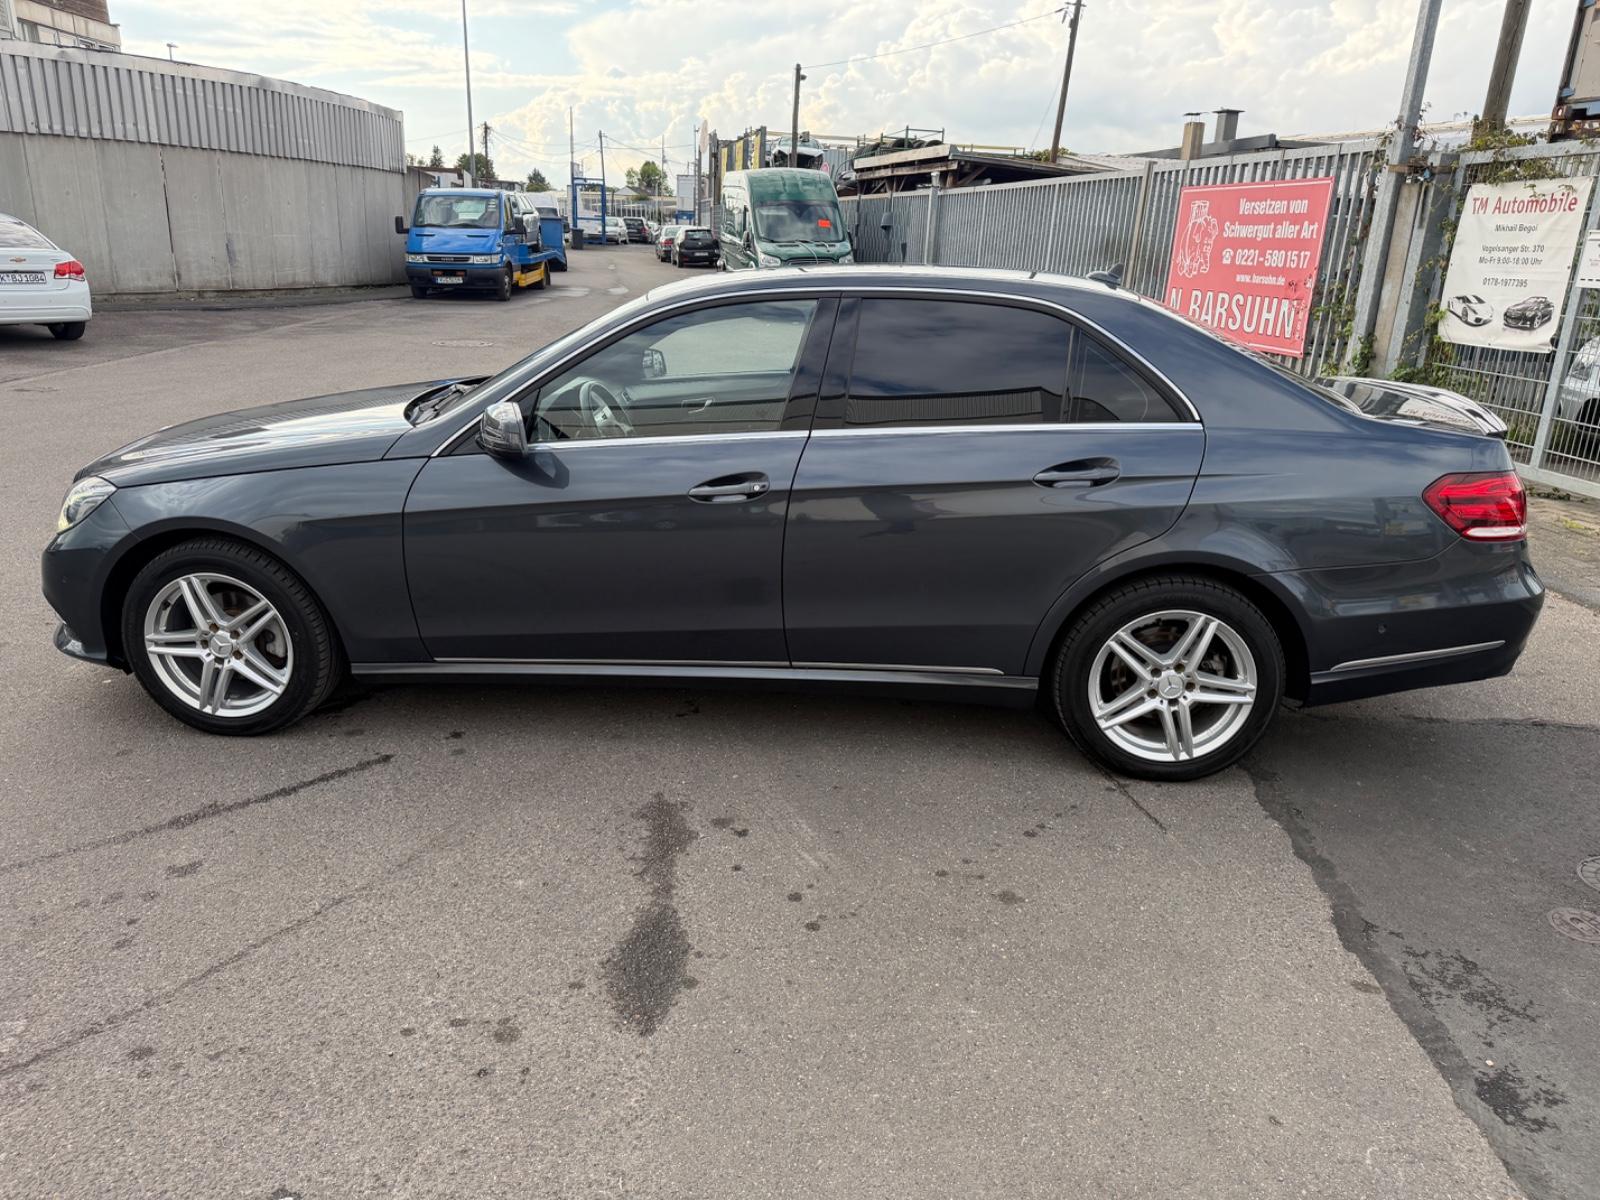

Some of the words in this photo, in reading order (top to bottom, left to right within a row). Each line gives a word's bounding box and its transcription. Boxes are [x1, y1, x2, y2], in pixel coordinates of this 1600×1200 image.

[1239, 198, 1287, 215] Versetzen
[1289, 199, 1308, 213] von
[1472, 196, 1489, 214] TM
[1492, 192, 1579, 214] Automobile
[1223, 221, 1274, 242] Schwergut
[1275, 222, 1299, 239] aller
[1301, 221, 1319, 239] Art
[1532, 244, 1545, 253] 370
[1530, 257, 1543, 266] Uhr
[1188, 289, 1296, 338] BARSUHN
